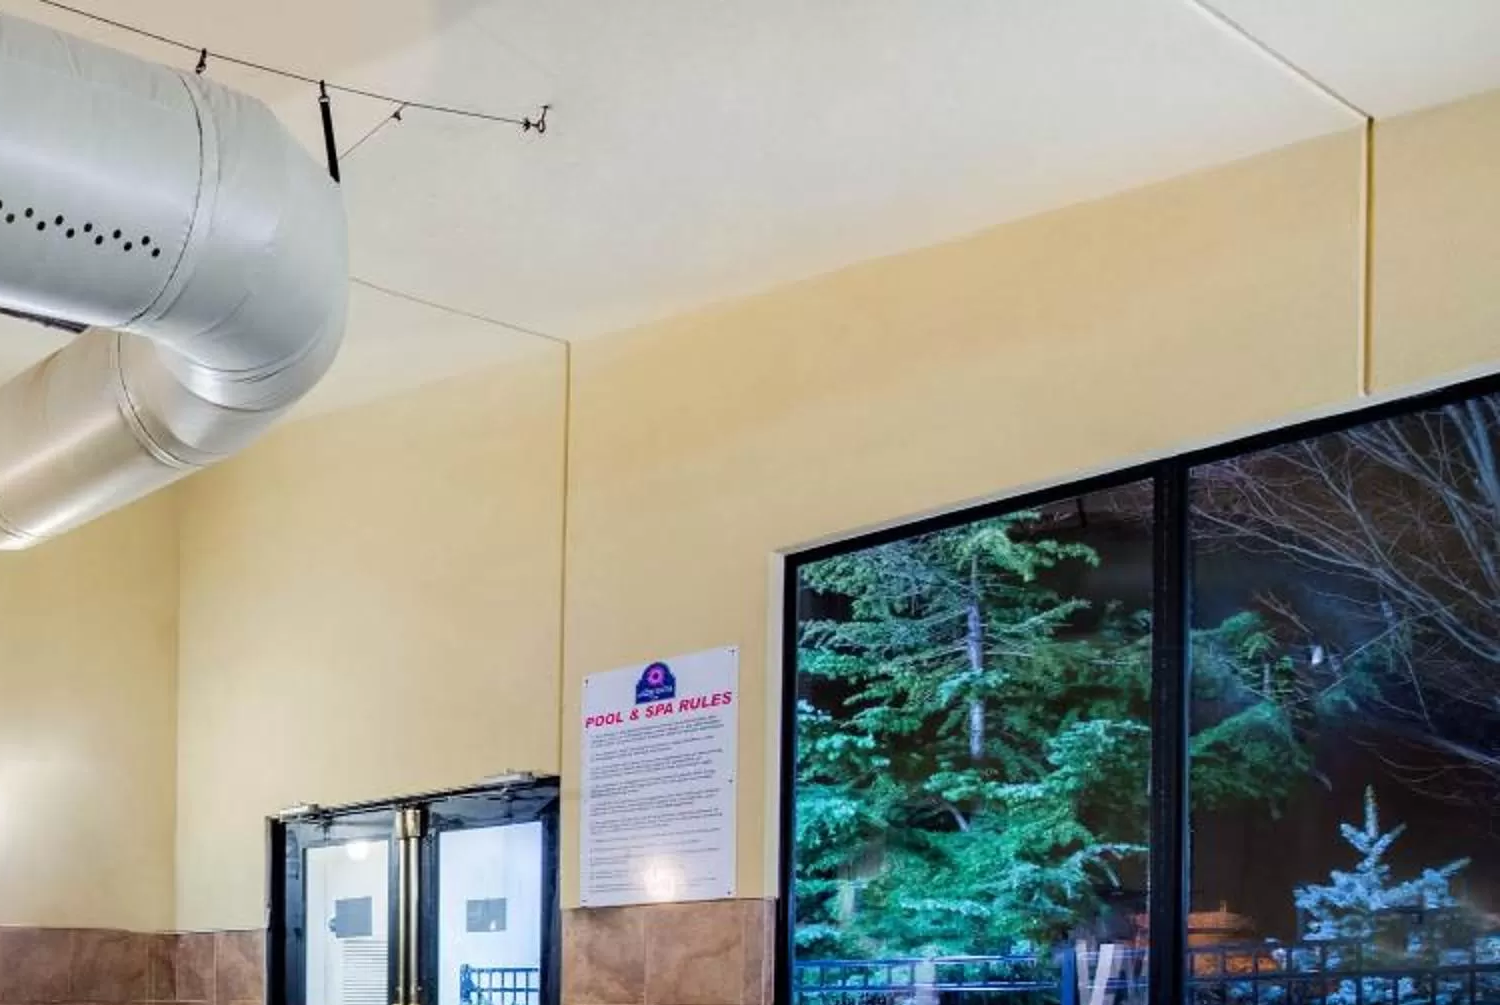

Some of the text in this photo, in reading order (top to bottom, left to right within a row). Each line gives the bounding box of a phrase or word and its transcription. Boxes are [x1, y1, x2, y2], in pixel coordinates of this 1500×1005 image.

[585, 712, 624, 729] POOL
[629, 708, 640, 721] &
[645, 703, 674, 718] SPA
[679, 691, 733, 712] RULES
